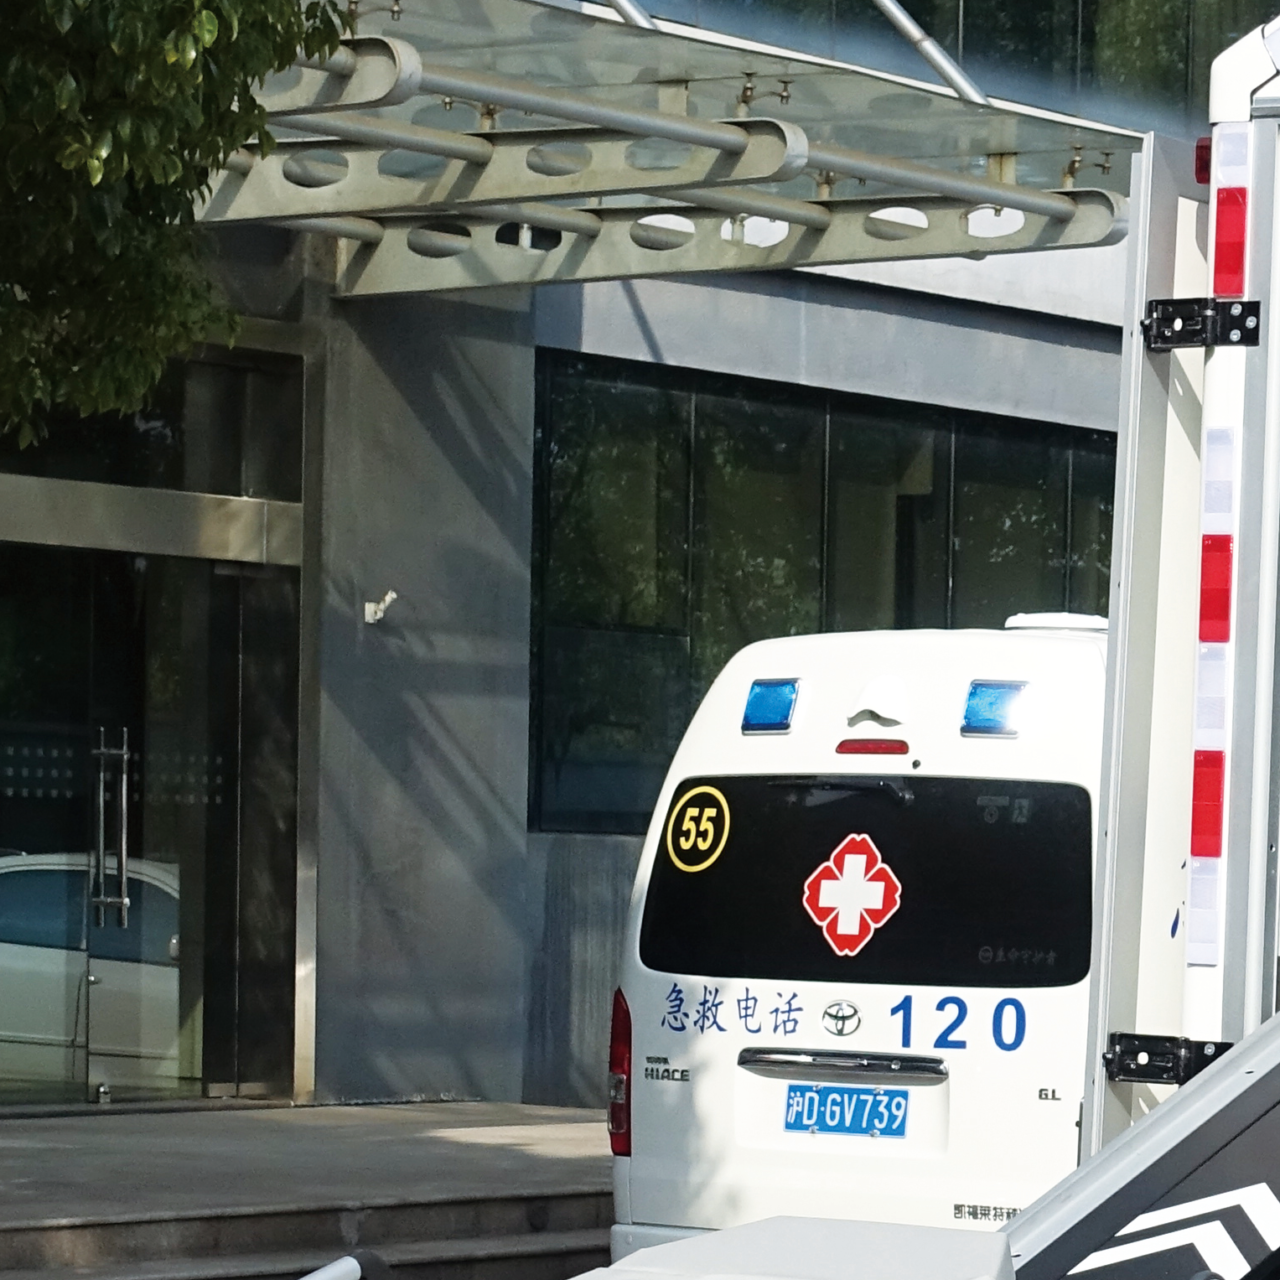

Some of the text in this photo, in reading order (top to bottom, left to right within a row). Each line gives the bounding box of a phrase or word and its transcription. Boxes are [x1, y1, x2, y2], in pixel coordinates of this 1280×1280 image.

[680, 807, 717, 851] 55
[661, 982, 803, 1036] 急救电话
[890, 995, 1026, 1052] 120
[644, 1066, 690, 1082] HIACE
[1038, 1088, 1062, 1101] GL
